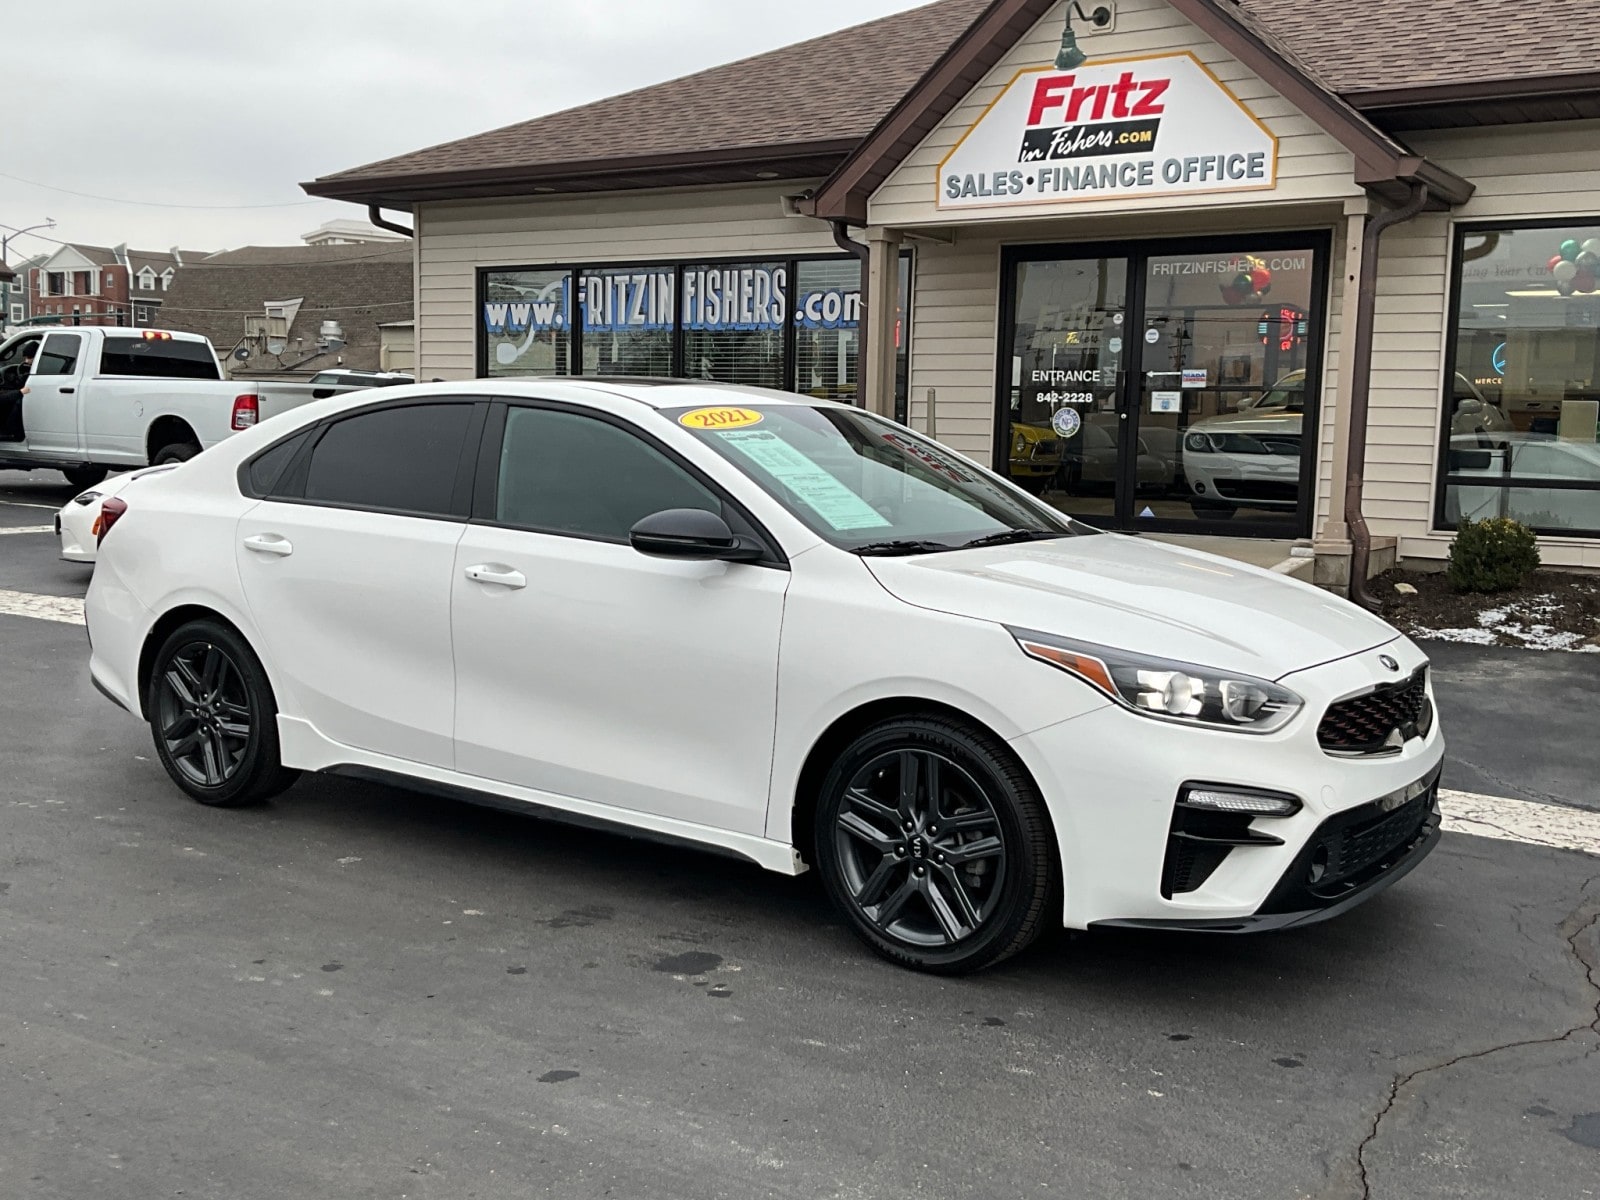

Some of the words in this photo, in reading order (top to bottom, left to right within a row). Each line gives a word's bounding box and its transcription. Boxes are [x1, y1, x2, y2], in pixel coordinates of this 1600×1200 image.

[1027, 72, 1171, 126] Fritz
[1021, 141, 1043, 162] in
[1162, 152, 1265, 184] OFFICE
[1032, 370, 1101, 382] ENTRANCE
[1036, 392, 1093, 403] 842-2228
[695, 409, 751, 427] 2021
[913, 837, 921, 858] KIA
